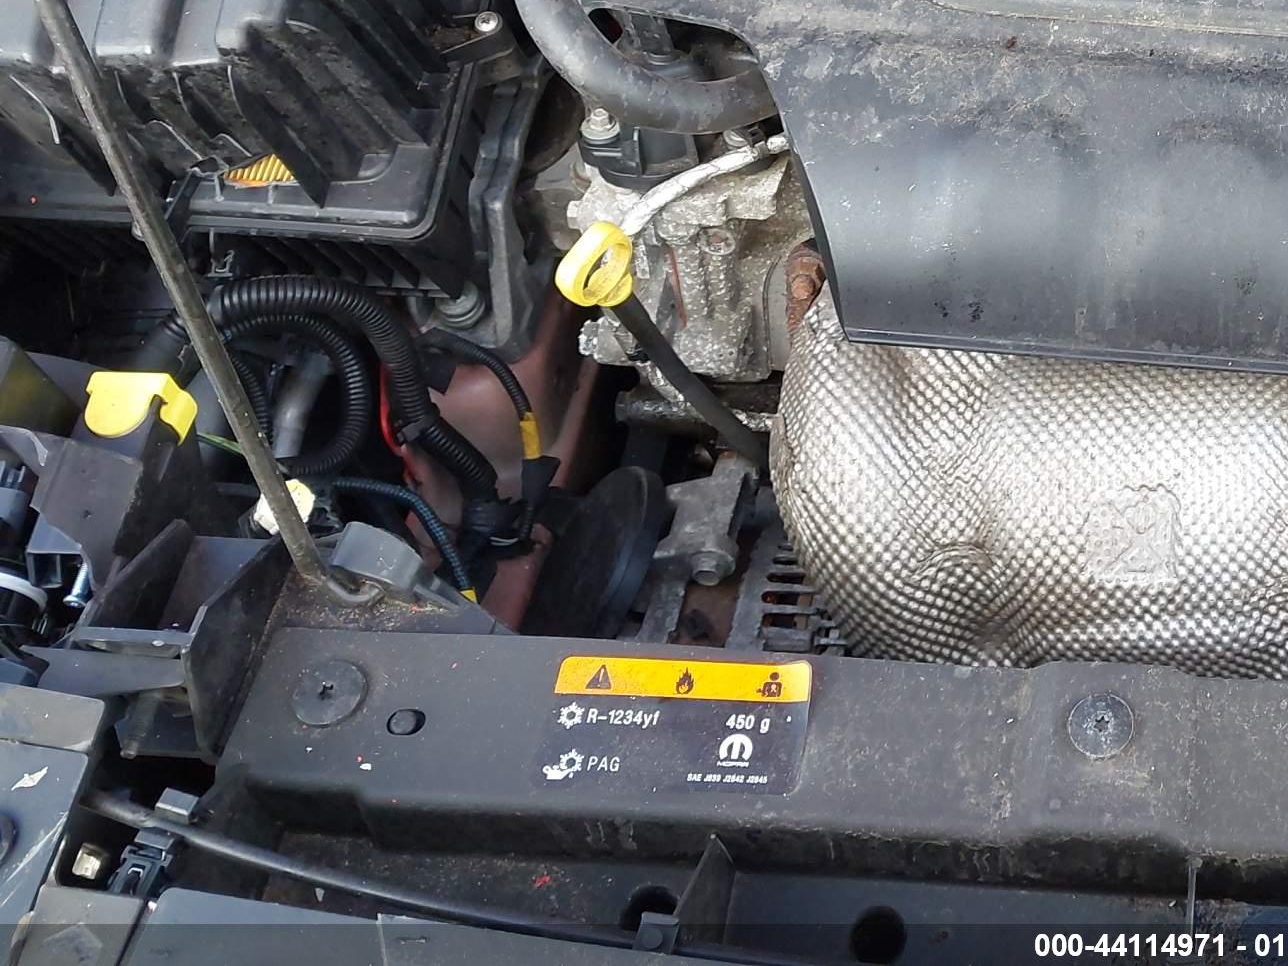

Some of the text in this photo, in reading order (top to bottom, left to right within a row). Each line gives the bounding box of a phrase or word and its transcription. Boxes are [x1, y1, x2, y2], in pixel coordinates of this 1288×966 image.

[586, 708, 770, 734] R-1234yf 450 g
[587, 755, 621, 772] PAG
[687, 773, 702, 782] SAE
